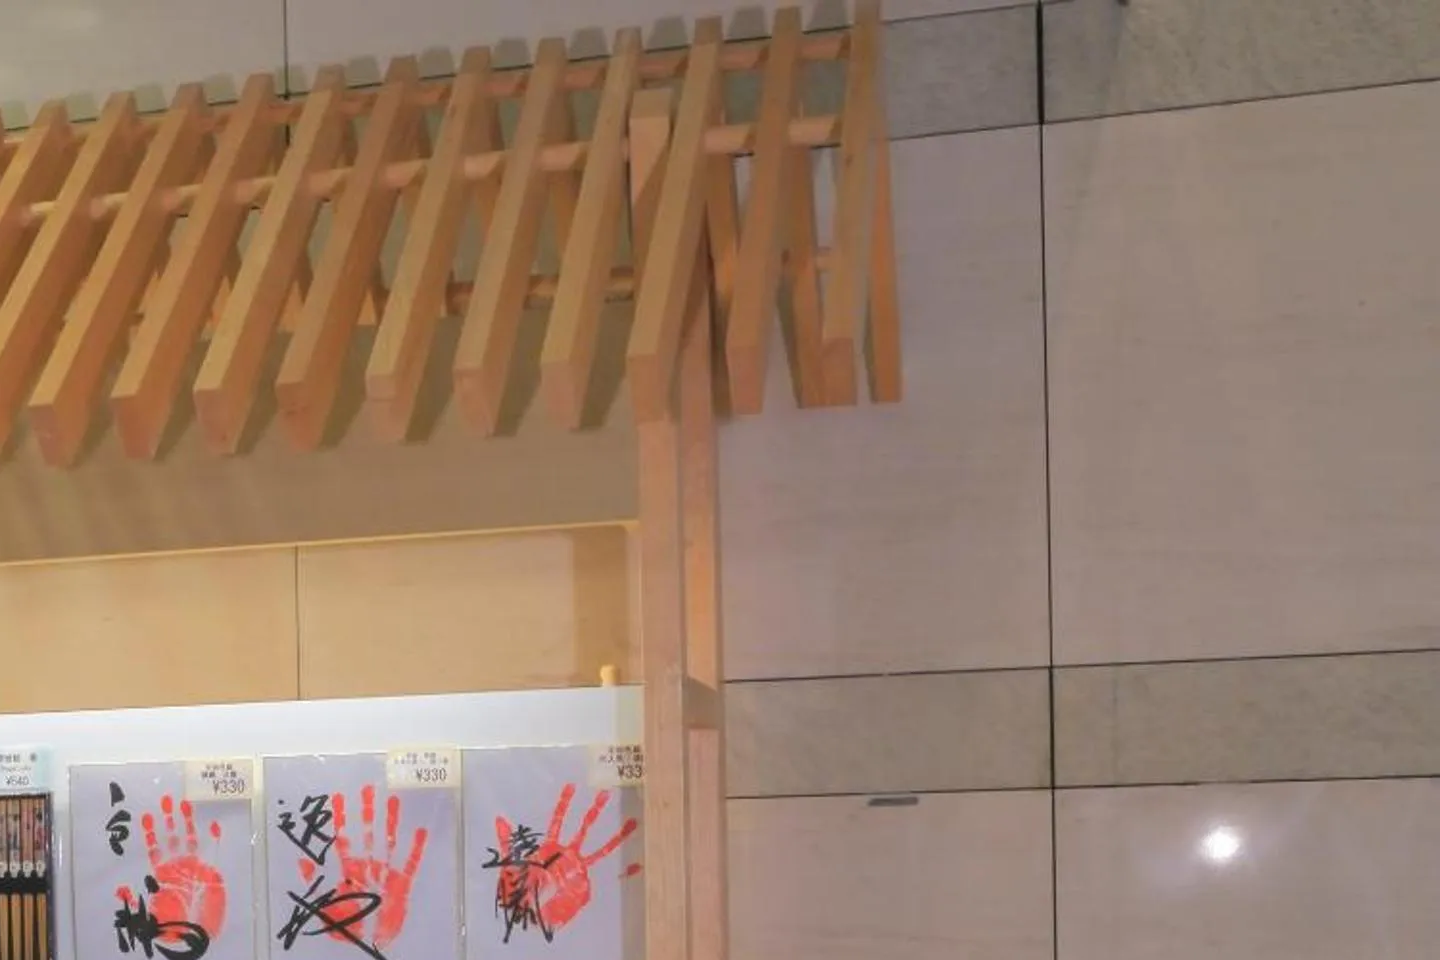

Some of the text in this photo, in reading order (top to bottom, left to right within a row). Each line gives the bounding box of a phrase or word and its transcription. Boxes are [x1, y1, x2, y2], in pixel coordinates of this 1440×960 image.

[416, 768, 448, 782] ¥330
[617, 764, 643, 779] ¥33
[213, 779, 245, 794] ¥330
